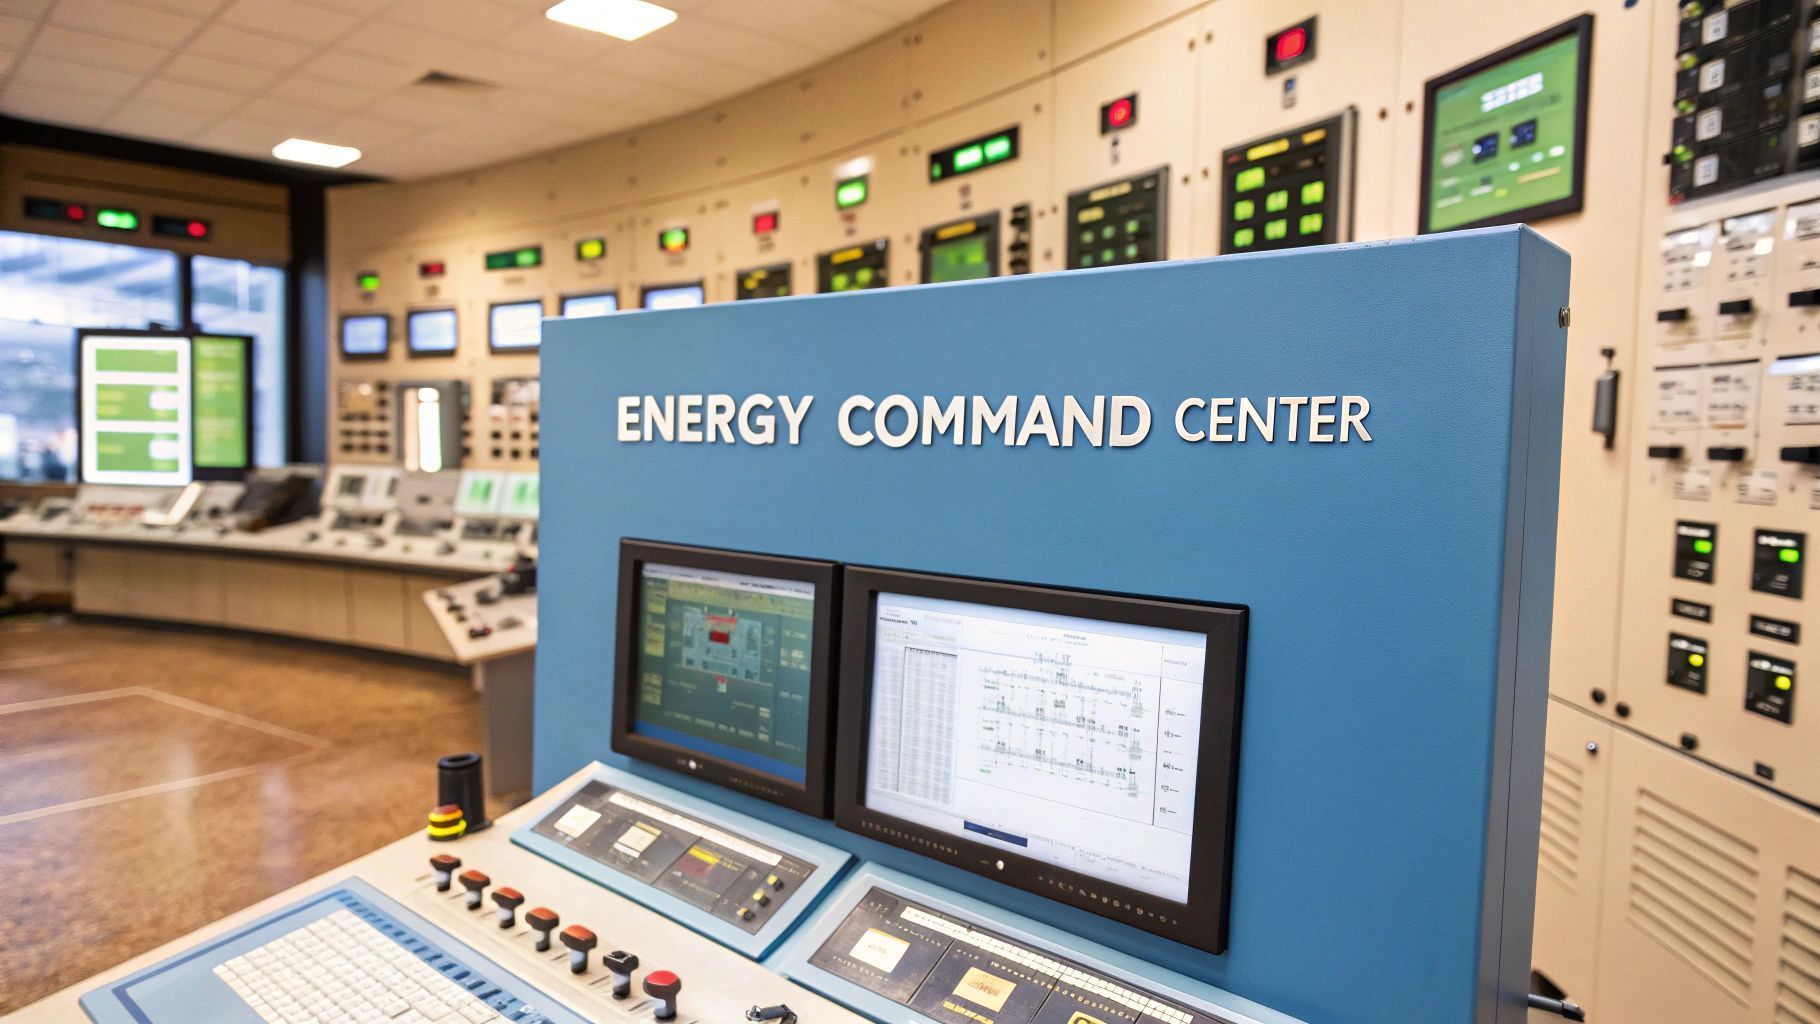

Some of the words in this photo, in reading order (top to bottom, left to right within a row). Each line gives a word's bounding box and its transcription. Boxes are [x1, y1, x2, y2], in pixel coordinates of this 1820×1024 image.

[616, 393, 814, 446] ENERGY
[837, 394, 1152, 448] COMMAND
[1174, 395, 1373, 443] CENTER
